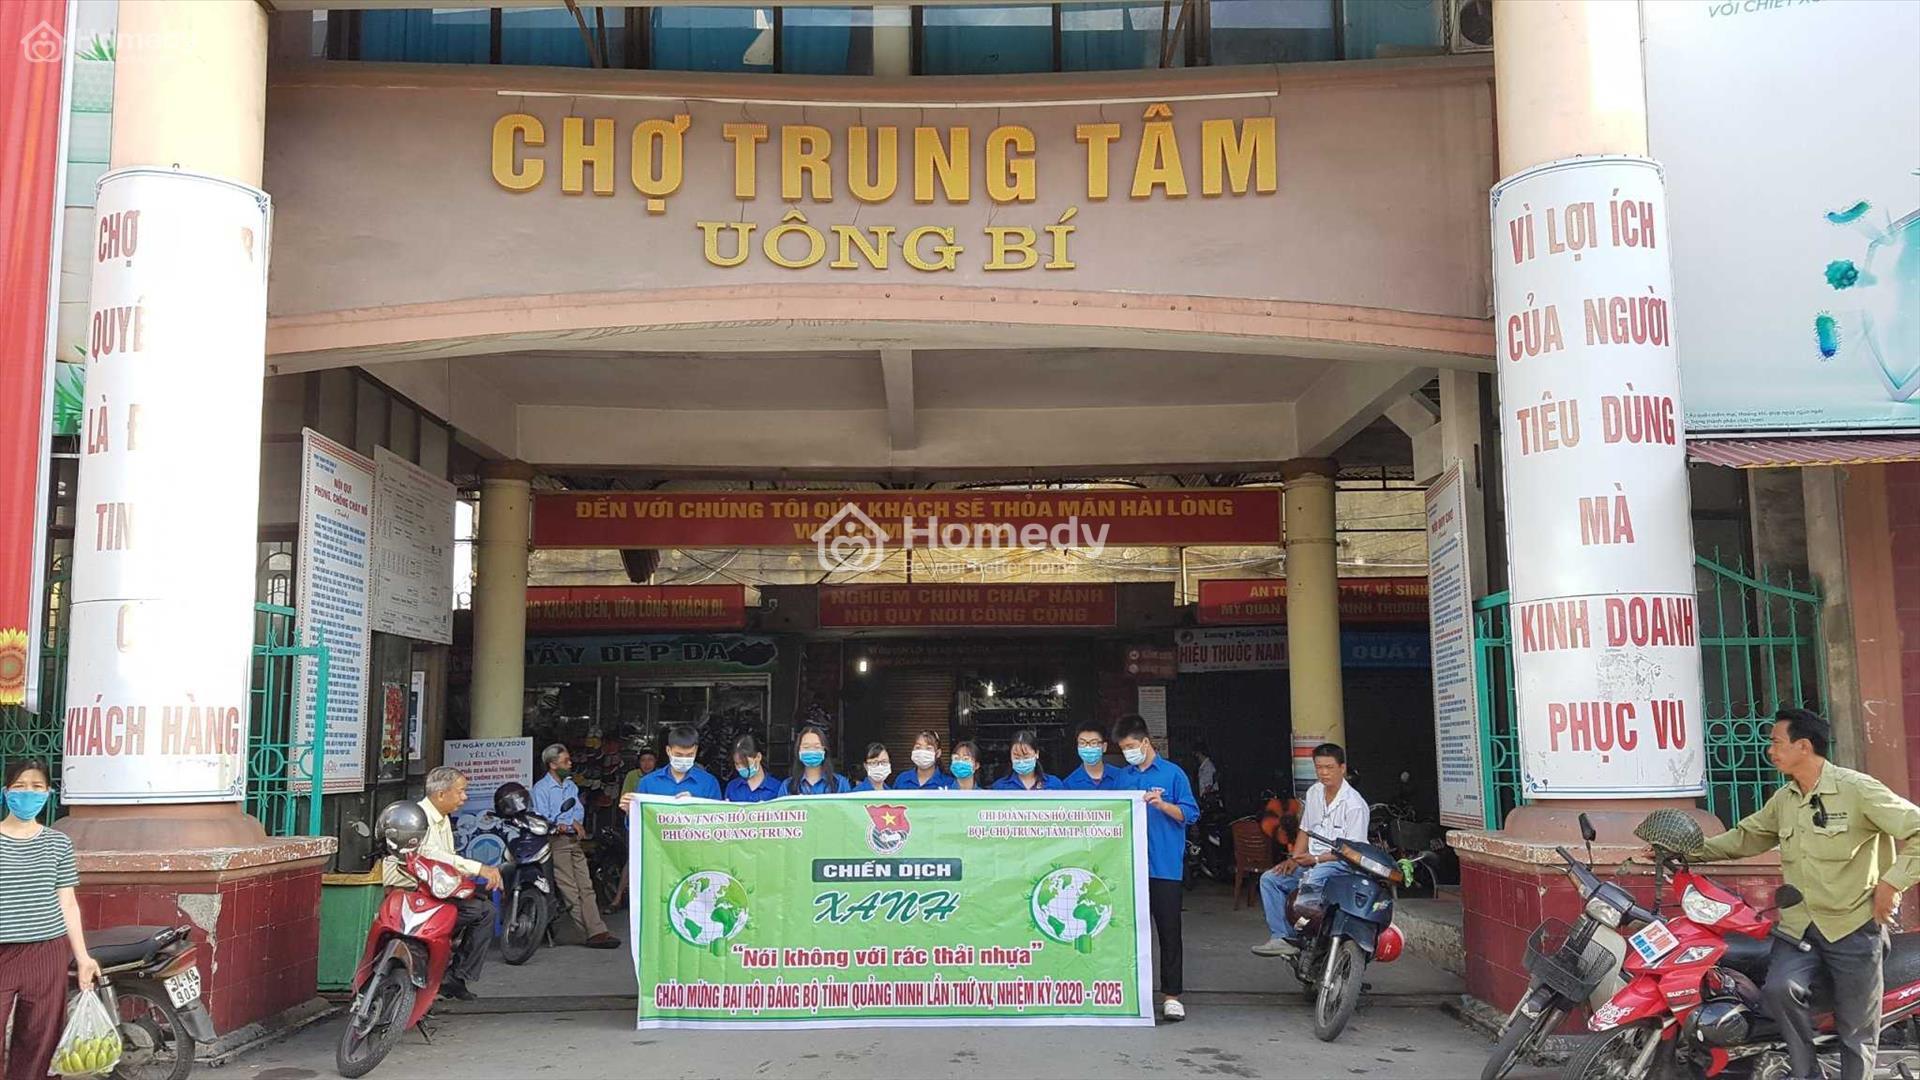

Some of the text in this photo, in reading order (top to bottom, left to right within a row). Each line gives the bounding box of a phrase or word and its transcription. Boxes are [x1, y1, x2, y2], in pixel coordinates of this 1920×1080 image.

[491, 104, 1277, 214] CHỢ TRUNG TÂM
[98, 210, 141, 267] CHỢ
[697, 206, 1078, 272] UÔNG BÍ
[1509, 188, 1656, 265] VÌ LỢI ÍCH
[1507, 285, 1670, 362] CỦA NGƯỜI
[87, 394, 109, 455] LÀ
[1516, 382, 1677, 456] TIÊU DÙNG
[576, 496, 627, 518] ĐẾN
[633, 496, 674, 518] VỚI
[679, 496, 764, 518] CHÚNG
[770, 497, 809, 518] TÔI
[868, 496, 949, 518] KHÁCH
[955, 496, 985, 517] SẼ
[991, 494, 1053, 517] THỎA
[1058, 496, 1115, 517] MÃN
[1120, 495, 1162, 517] HÀI
[1167, 494, 1234, 517] LÒNG
[1579, 482, 1635, 545] MÀ
[1250, 586, 1288, 597] AN TO
[1396, 584, 1429, 597] SINH
[544, 596, 582, 618] KHÁCH
[639, 596, 669, 617] LÒNG
[671, 596, 708, 617] KHÁCH
[1520, 596, 1694, 653] KINH DOANH
[682, 642, 729, 661] DA
[1179, 642, 1208, 667] HIỆU
[1212, 639, 1251, 663] THUỐC
[1255, 643, 1285, 661] NAM
[66, 693, 239, 757] KHÁCH HÀNG
[1548, 700, 1636, 763] PHỤC
[656, 810, 693, 825] ĐOÀN
[695, 810, 725, 824] TNCS
[727, 807, 747, 824] HỒ
[770, 810, 807, 823] MINH
[1085, 809, 1112, 821] MINH
[713, 827, 757, 842] QUANG
[759, 826, 803, 840] TRUNG
[1012, 826, 1045, 838] TRUNG
[823, 859, 952, 880] CHIẾN DỊCH
[814, 891, 960, 922] XANH
[784, 944, 850, 970] không
[855, 944, 887, 966] với
[894, 945, 927, 966] rác
[933, 943, 975, 965] thải
[655, 977, 684, 1008] CHÀO
[686, 977, 720, 1008] MỪNG
[722, 979, 743, 1015] ĐẠI
[745, 977, 765, 1014] HỘI
[767, 975, 800, 1008] ĐẢNG
[802, 977, 819, 1014] BỘ
[821, 977, 849, 1007] TỈNH
[850, 975, 891, 1010] QUẢNG
[894, 980, 924, 1007] NINH
[927, 974, 950, 1006] LẦN
[952, 975, 975, 1006] THỨ
[996, 977, 1035, 1011] NHIỆM
[1036, 975, 1053, 1006] KỲ
[1054, 980, 1083, 1005] 2020
[1093, 979, 1124, 1005] 2025
